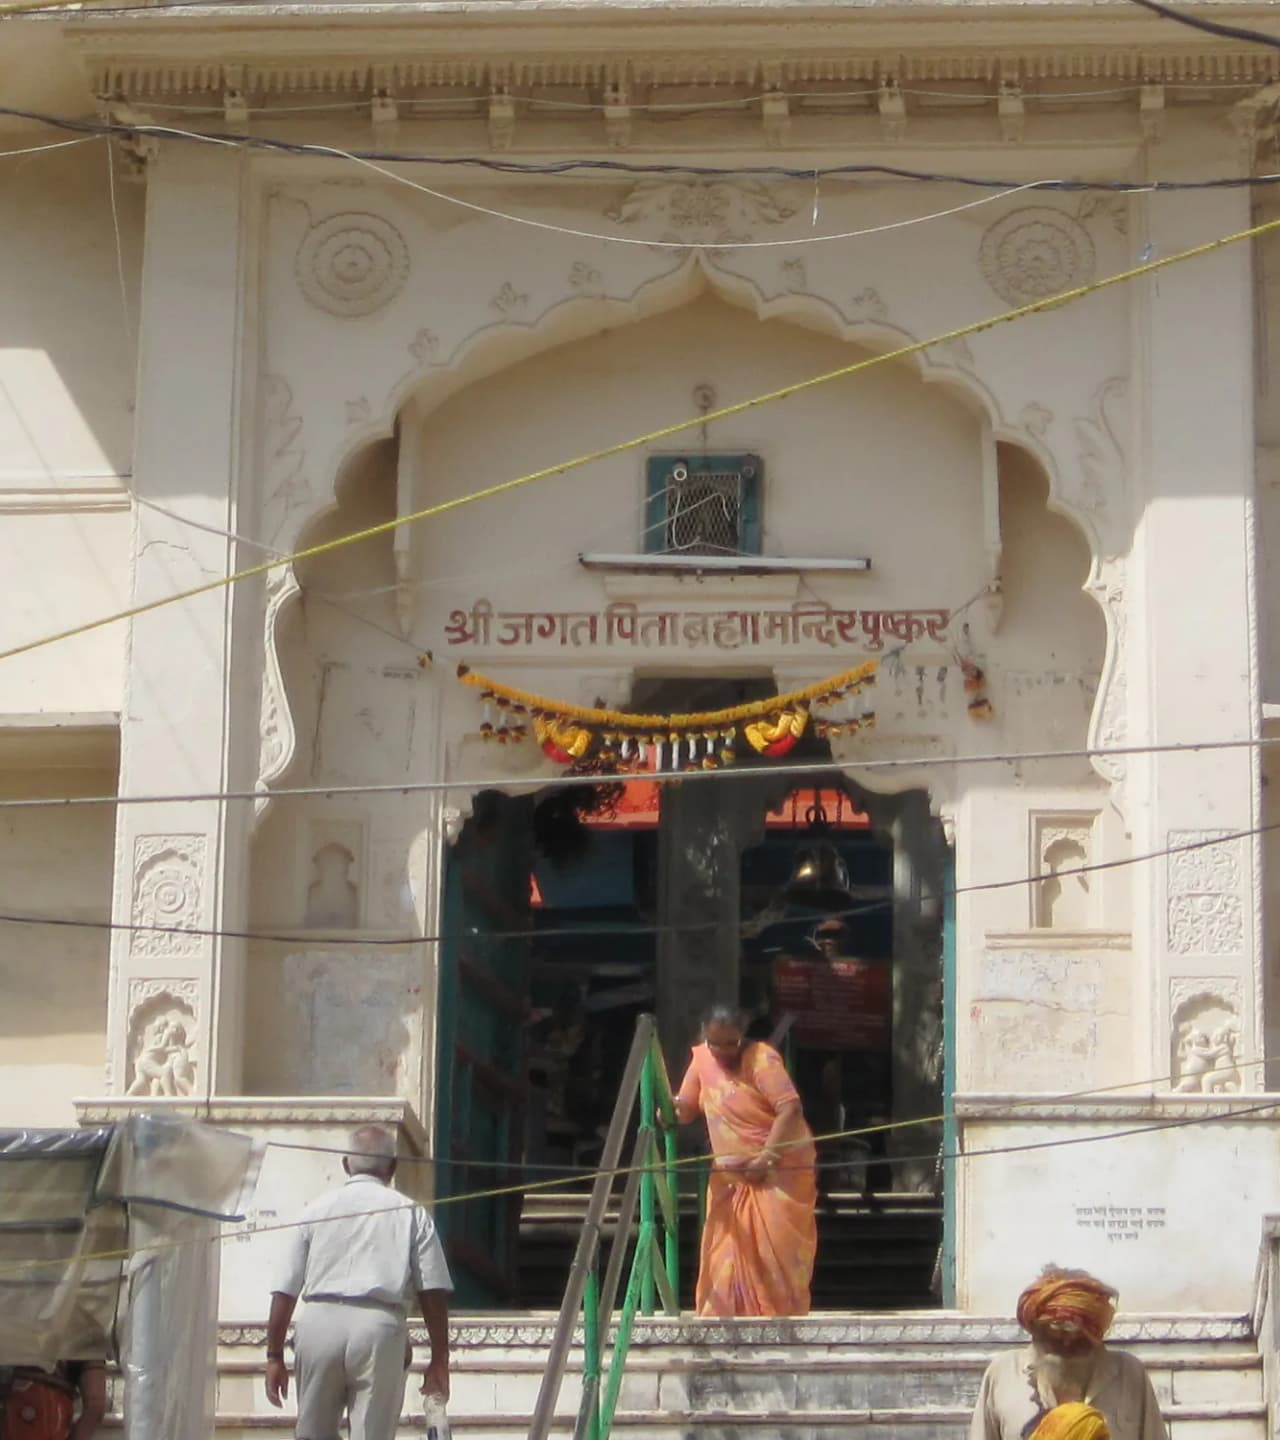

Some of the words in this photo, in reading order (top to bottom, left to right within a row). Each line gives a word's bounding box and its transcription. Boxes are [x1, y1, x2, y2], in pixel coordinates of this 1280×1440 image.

[444, 597, 495, 647] श्री
[496, 607, 599, 647] जगत
[604, 601, 679, 648] पिता
[858, 606, 951, 652] पुष्कर
